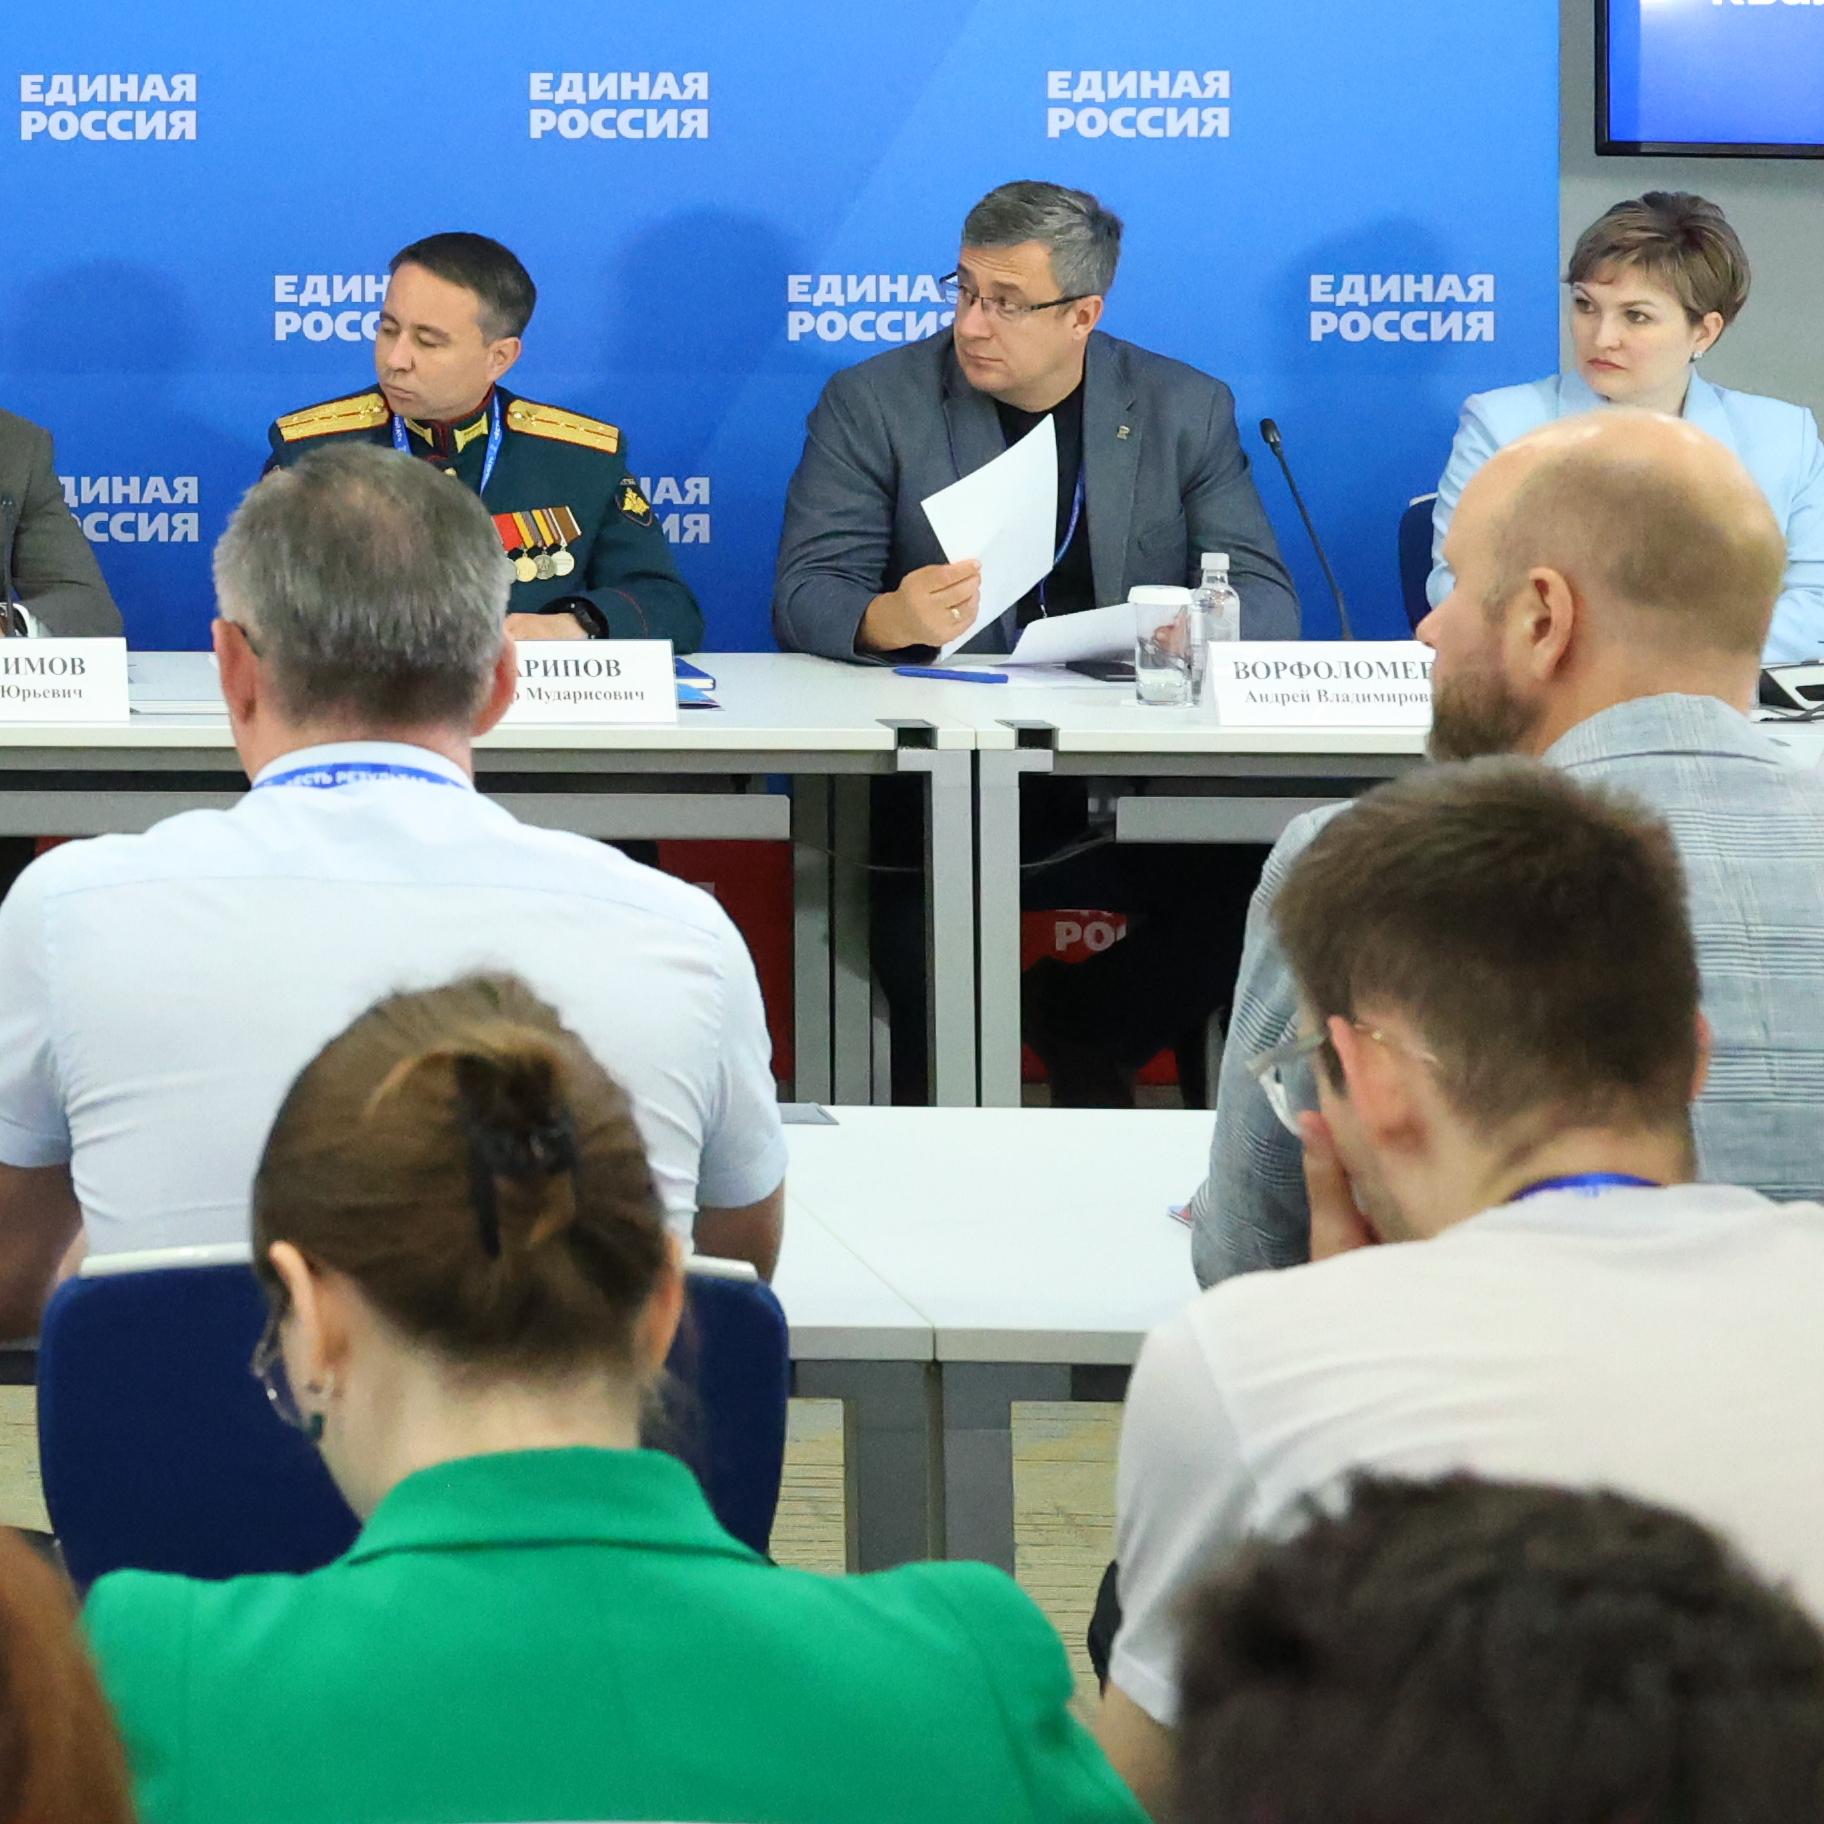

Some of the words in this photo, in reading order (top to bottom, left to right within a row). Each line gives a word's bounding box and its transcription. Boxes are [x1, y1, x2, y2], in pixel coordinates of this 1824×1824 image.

[21, 74, 196, 106] ЕДИНАЯ
[530, 72, 708, 104] ЕДИНАЯ
[1047, 70, 1230, 102] ЕДИНАЯ
[21, 110, 196, 140] РОССИЯ
[530, 109, 708, 138] РОССИЯ
[1047, 107, 1230, 138] РОССИЯ
[274, 275, 389, 307] ЕДИН
[1311, 274, 1494, 306] ЕДИНАЯ
[274, 311, 379, 342] РОСС
[1311, 311, 1494, 341] РОССИЯ
[58, 477, 198, 507] ДИНАЯ
[76, 512, 199, 542] ССИЯ
[518, 659, 622, 678] РИПОВ
[1233, 660, 1433, 680] ВОРФОЛОМЕЕ
[1, 685, 82, 702] Юрьевич
[527, 688, 643, 704] Мударисович
[1245, 688, 1311, 707] Андрей
[1316, 688, 1430, 707] Владимиров
